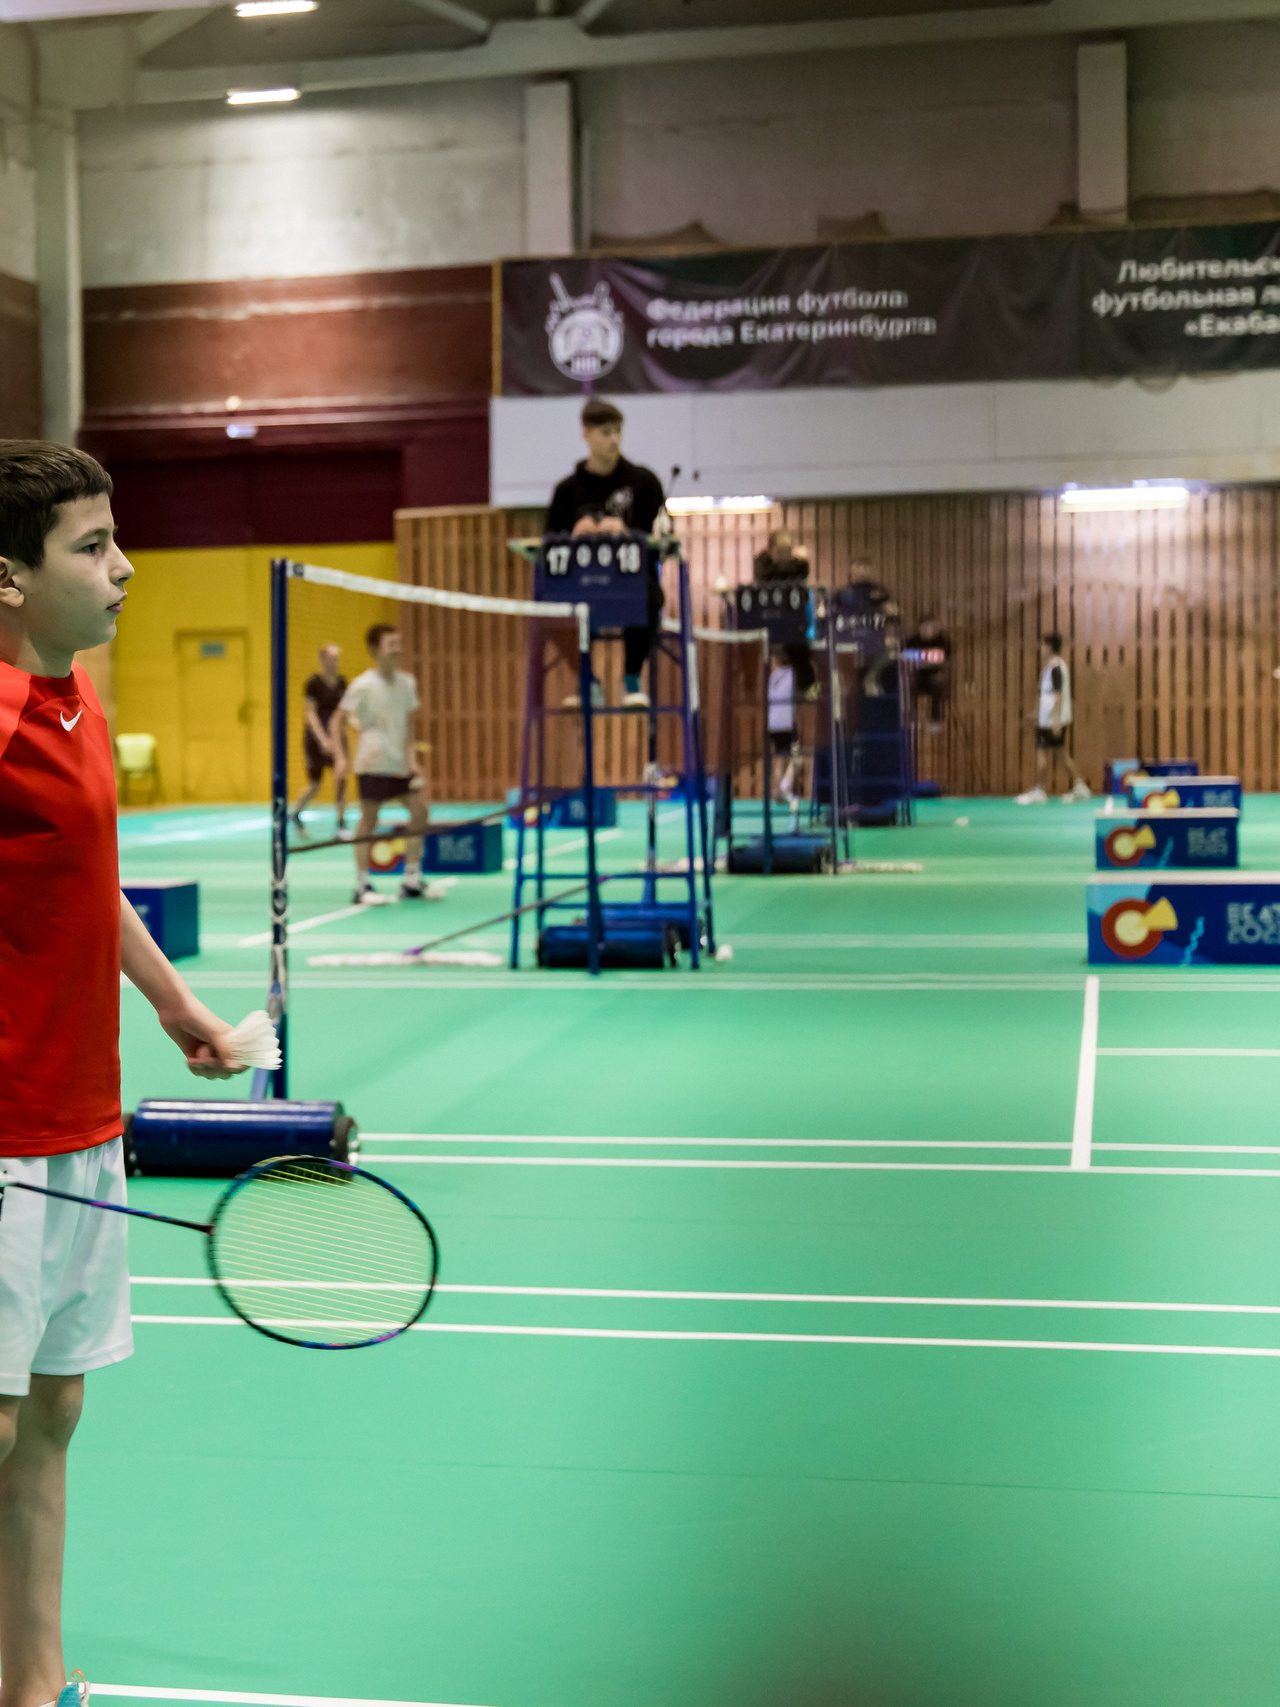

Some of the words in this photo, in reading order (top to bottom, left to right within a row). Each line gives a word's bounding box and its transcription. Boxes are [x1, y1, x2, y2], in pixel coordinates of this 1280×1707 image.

[646, 295, 791, 323] Федерация
[796, 287, 908, 317] футбола
[1091, 286, 1256, 319] футбольная
[646, 324, 735, 351] города
[740, 313, 937, 344] Екатеринбурга
[546, 545, 571, 576] 17
[576, 544, 591, 568] 0
[597, 544, 612, 567] 0
